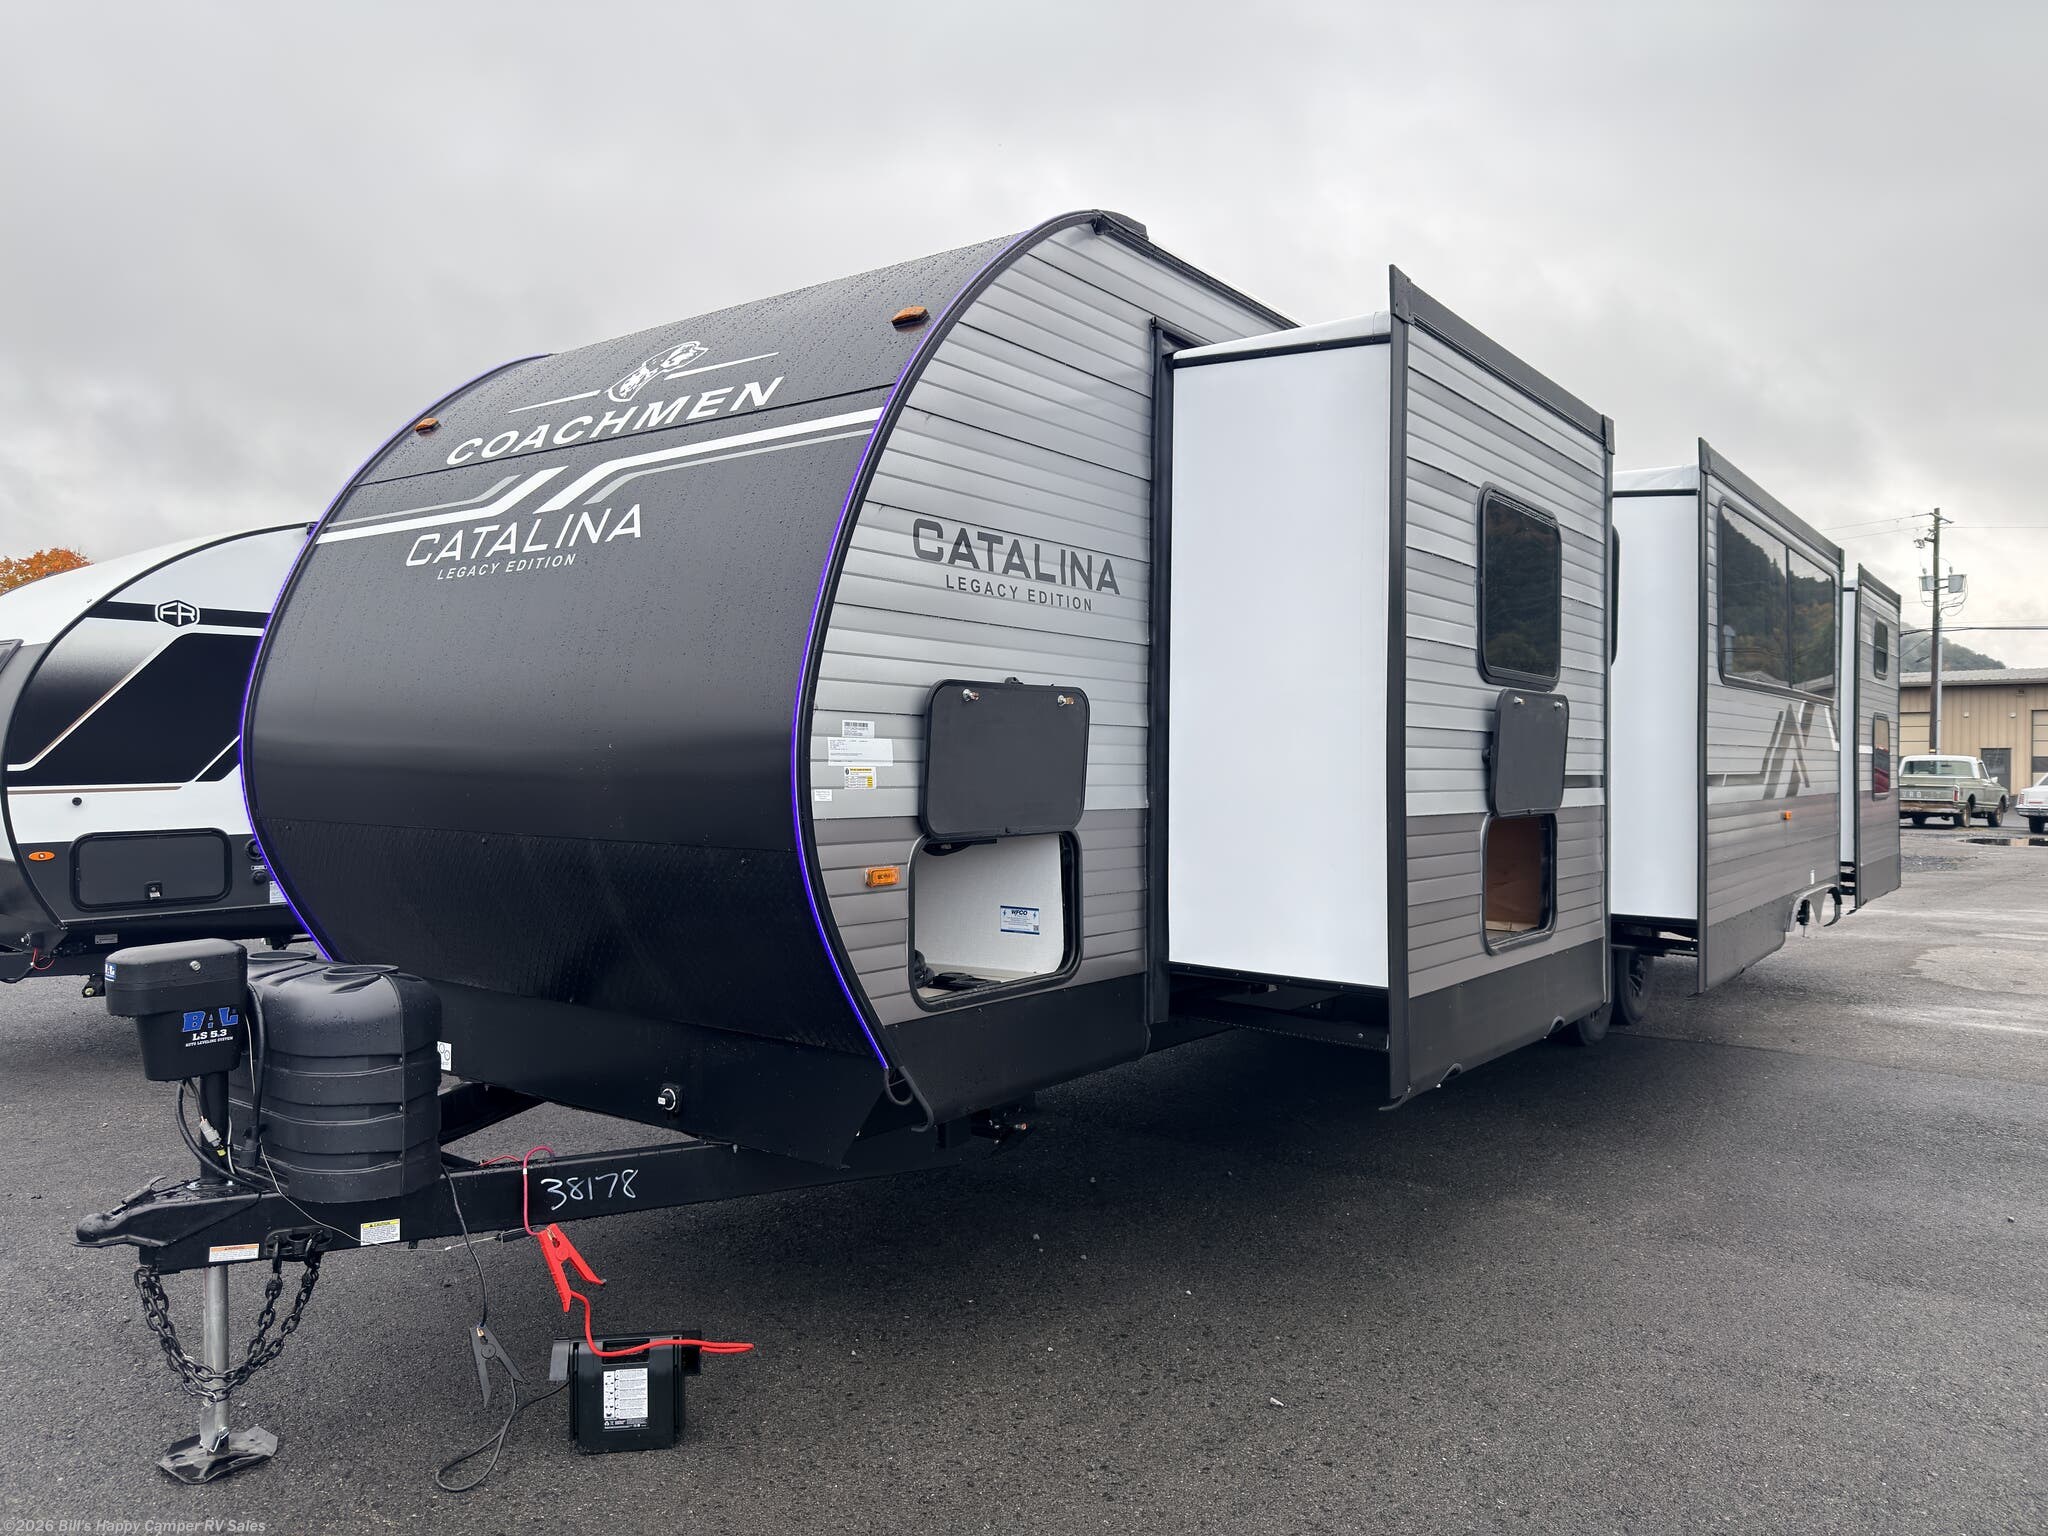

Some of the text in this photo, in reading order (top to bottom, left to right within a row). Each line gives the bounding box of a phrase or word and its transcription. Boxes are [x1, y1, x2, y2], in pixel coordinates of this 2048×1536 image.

[446, 376, 784, 465] COACHMEN
[405, 503, 641, 567] CATALINA
[437, 553, 577, 580] LEGACY EDITION
[912, 518, 1121, 595] CATALINA
[946, 574, 1092, 611] LEGACY EDITION
[192, 1031, 208, 1041] LS
[540, 1169, 639, 1211] 38178
